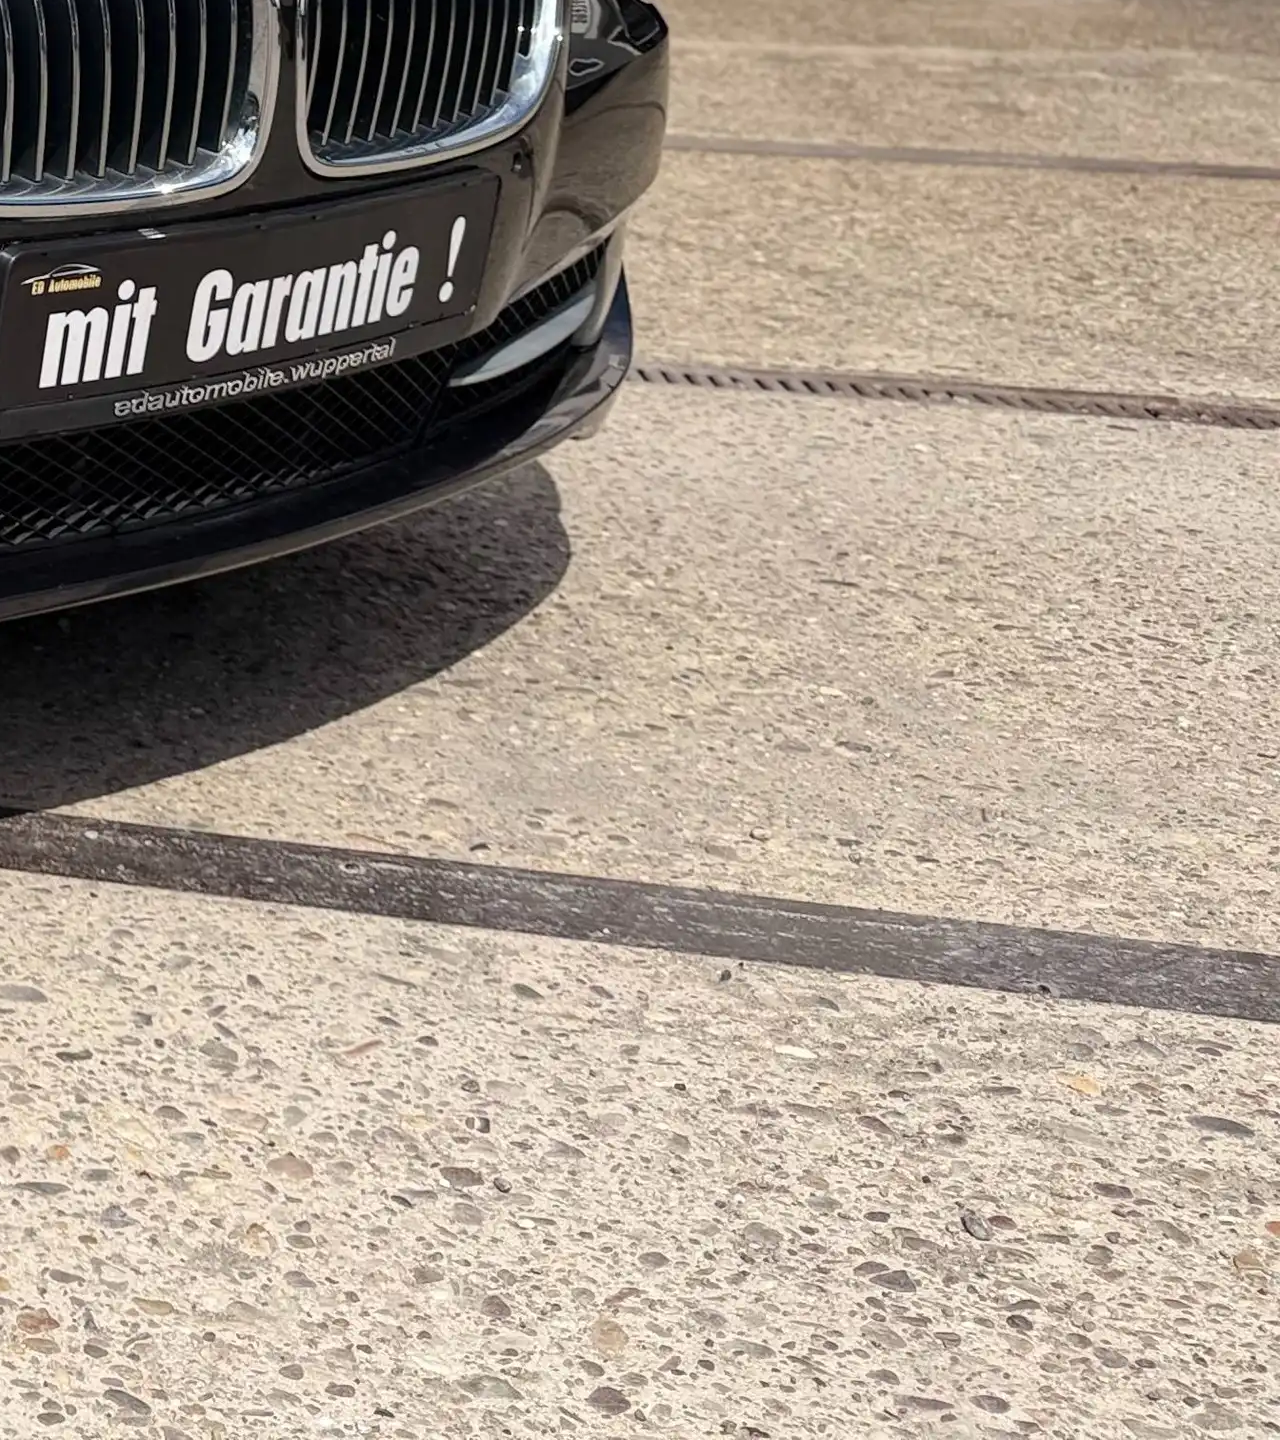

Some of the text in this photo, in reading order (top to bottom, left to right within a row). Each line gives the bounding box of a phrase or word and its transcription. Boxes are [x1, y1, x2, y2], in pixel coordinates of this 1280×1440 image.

[31, 273, 102, 296] ED Automobile
[39, 216, 467, 389] mit Garantie !
[113, 342, 396, 418] edautomobile.wuppertal
